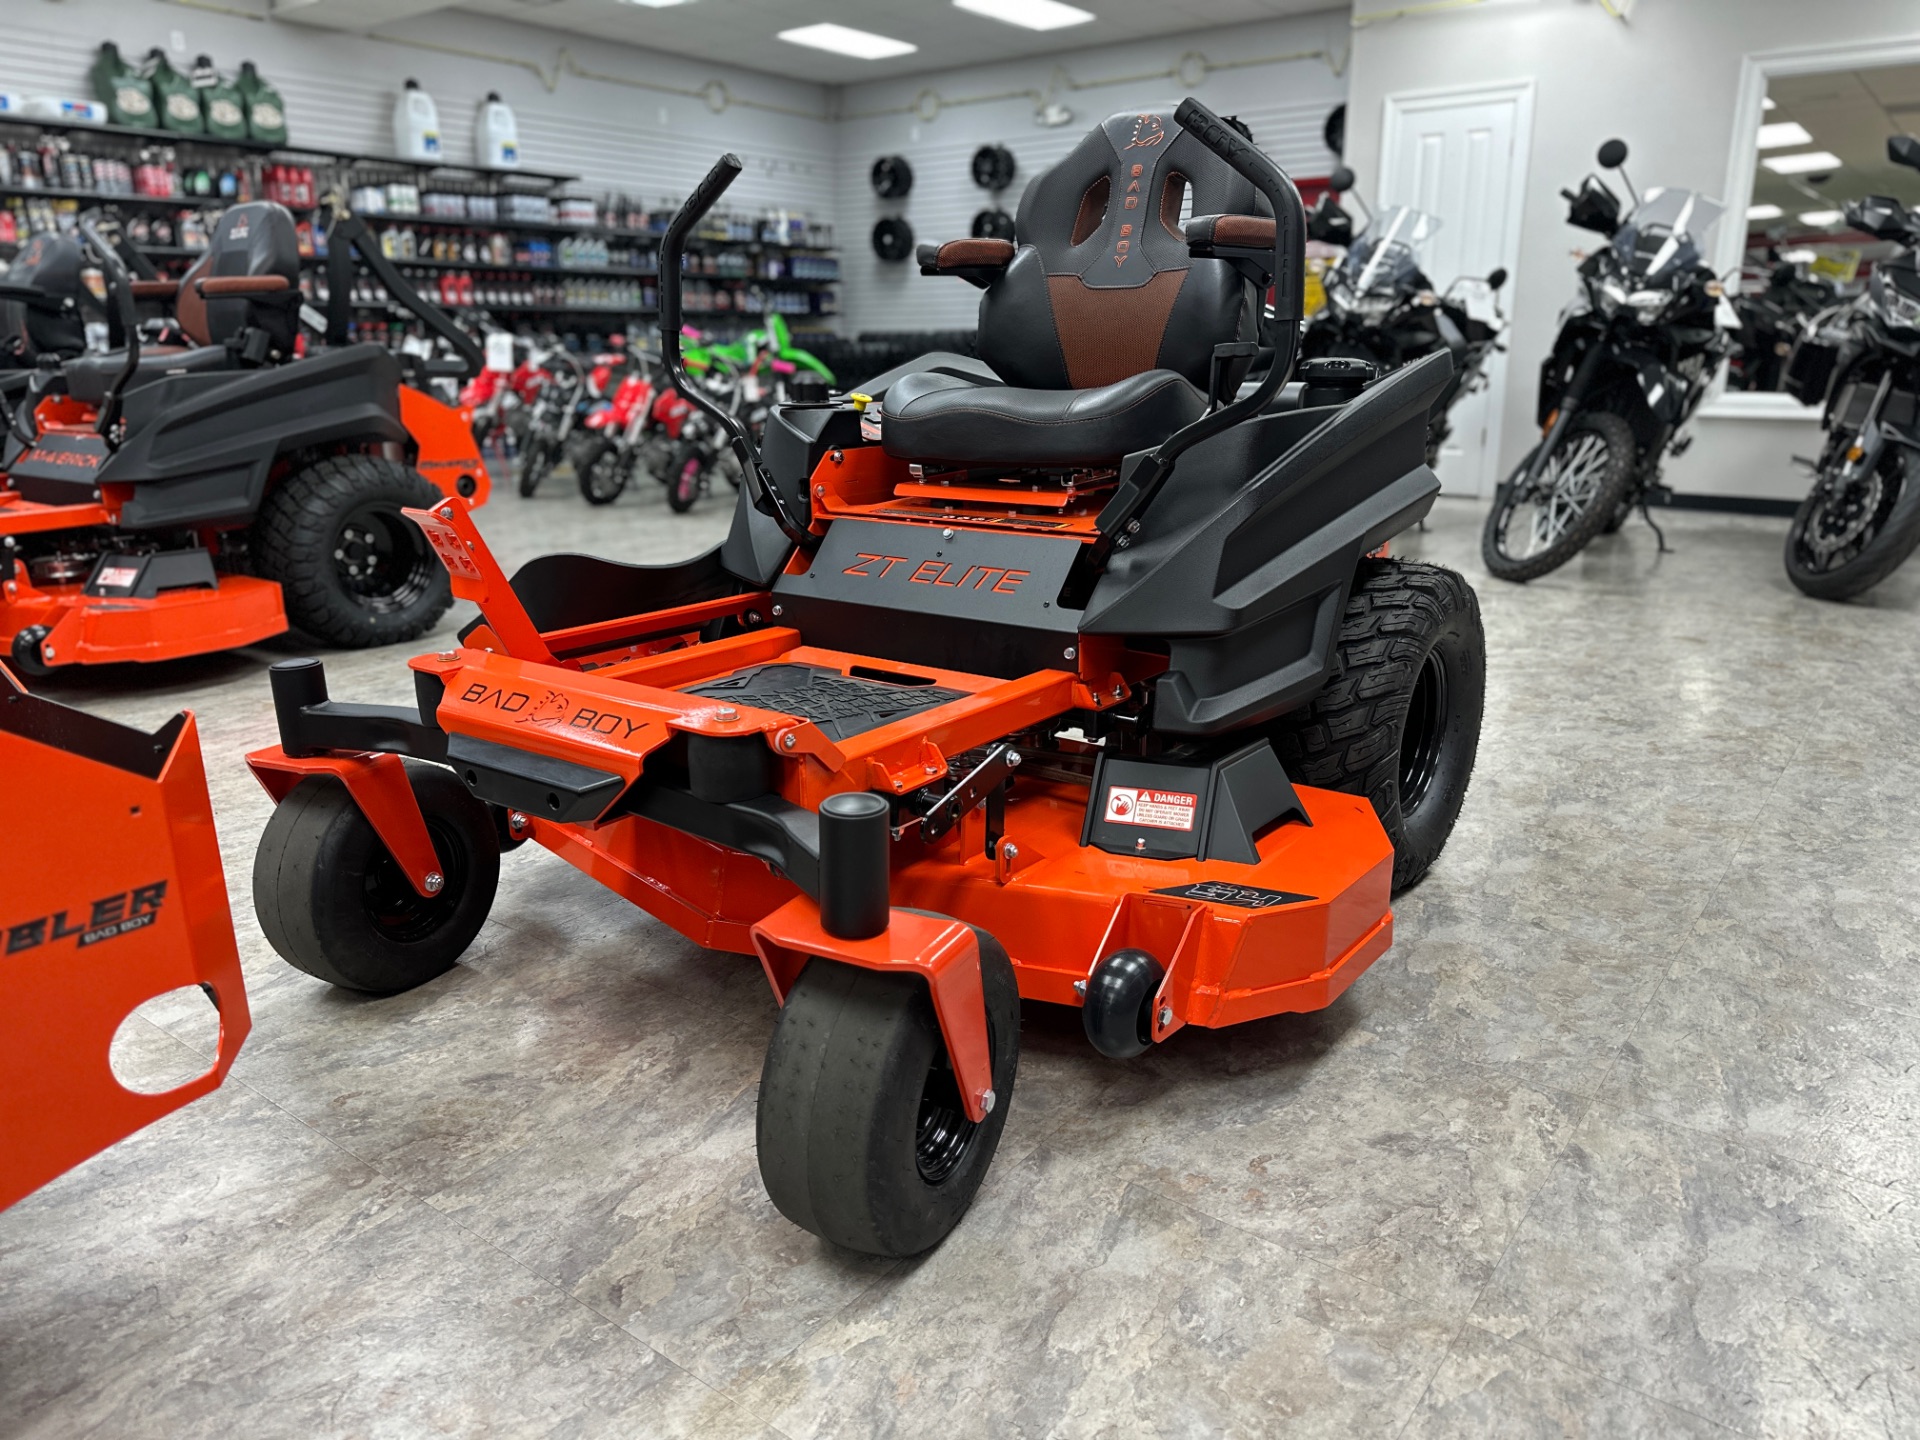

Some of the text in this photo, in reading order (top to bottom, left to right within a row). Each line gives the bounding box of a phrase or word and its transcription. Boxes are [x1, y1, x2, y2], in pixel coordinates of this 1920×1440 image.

[1114, 164, 1144, 268] BAD BOY
[842, 552, 1031, 595] ZT ELITE
[461, 683, 649, 739] BAD BOY
[1154, 793, 1193, 806] DANGER
[0, 880, 168, 955] BLER
[83, 914, 152, 944] BAD BOY
